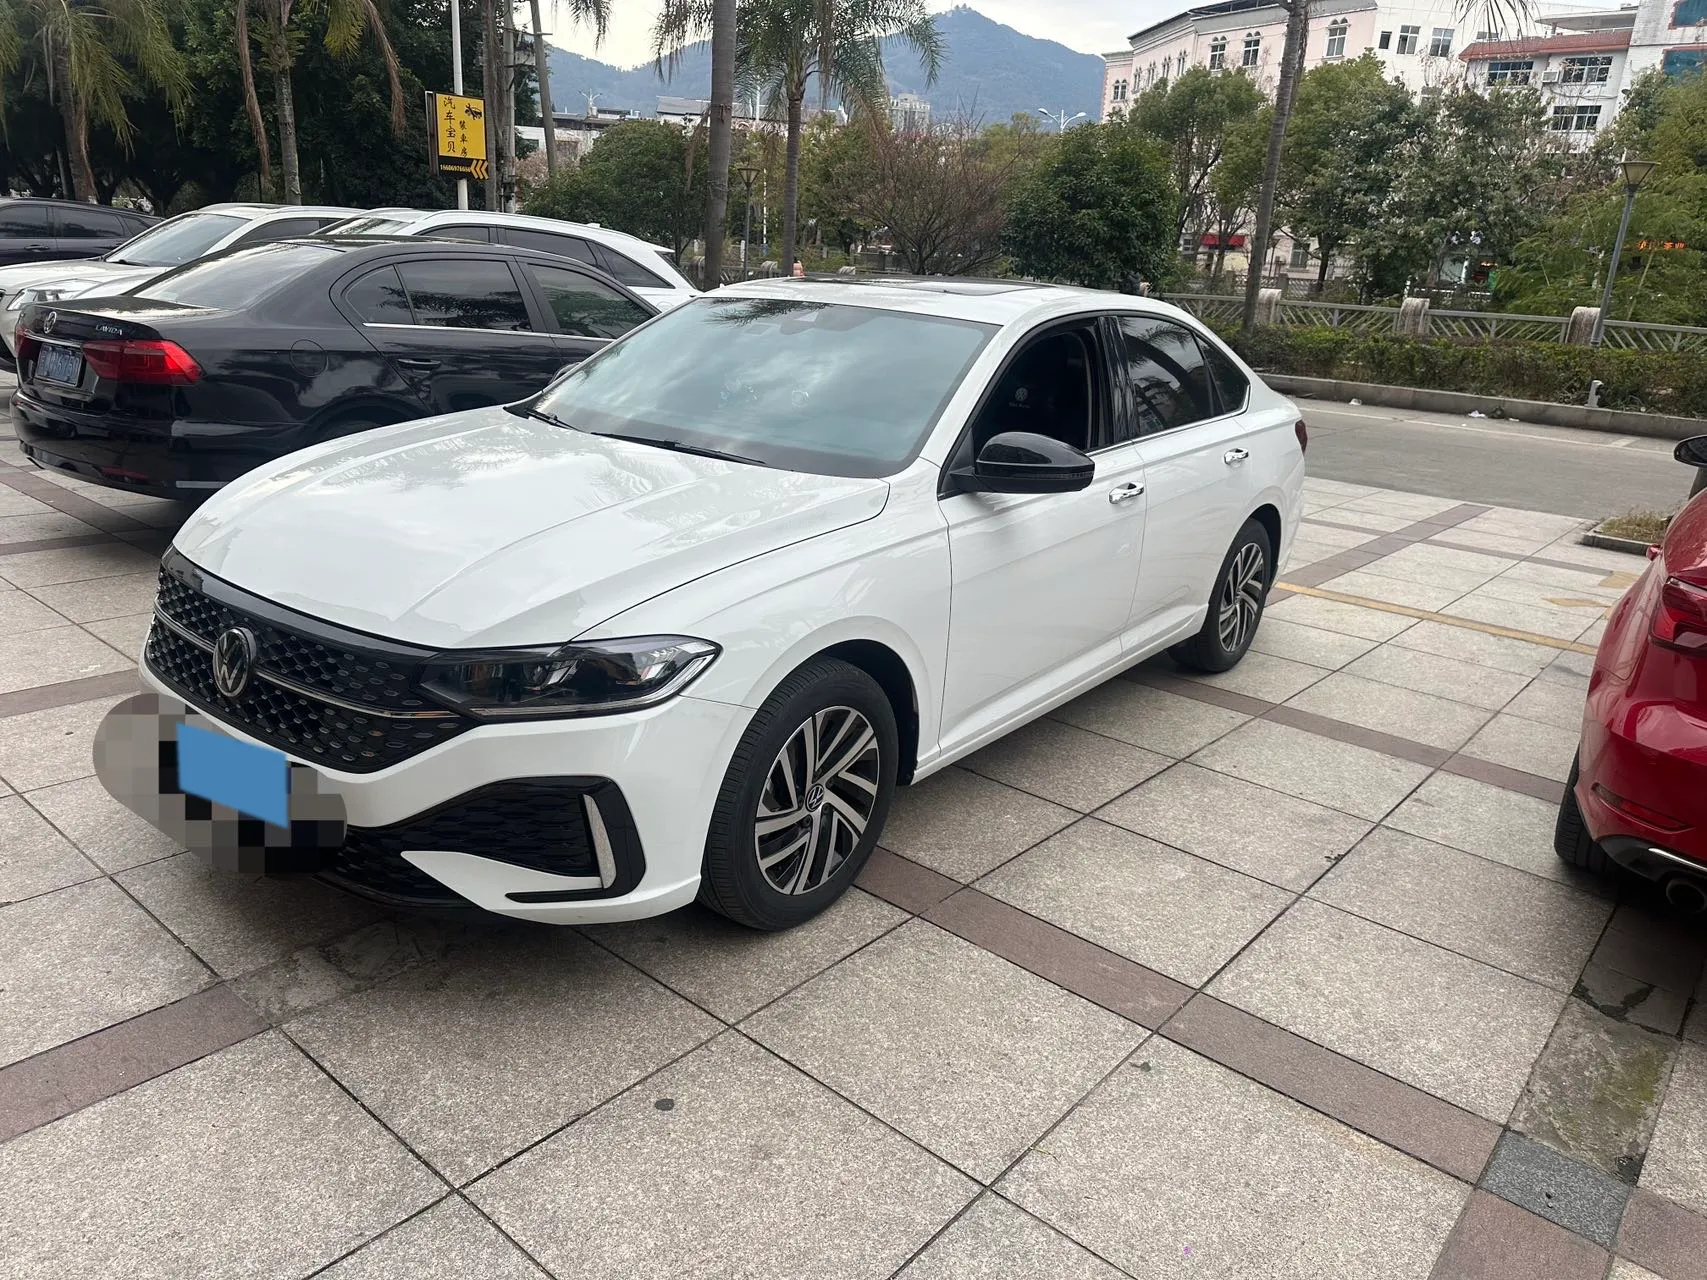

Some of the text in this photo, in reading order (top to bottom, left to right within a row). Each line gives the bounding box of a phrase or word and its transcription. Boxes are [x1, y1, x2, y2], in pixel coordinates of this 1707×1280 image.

[443, 96, 456, 153] 汽车宝贝
[95, 323, 123, 336] LAVIDA
